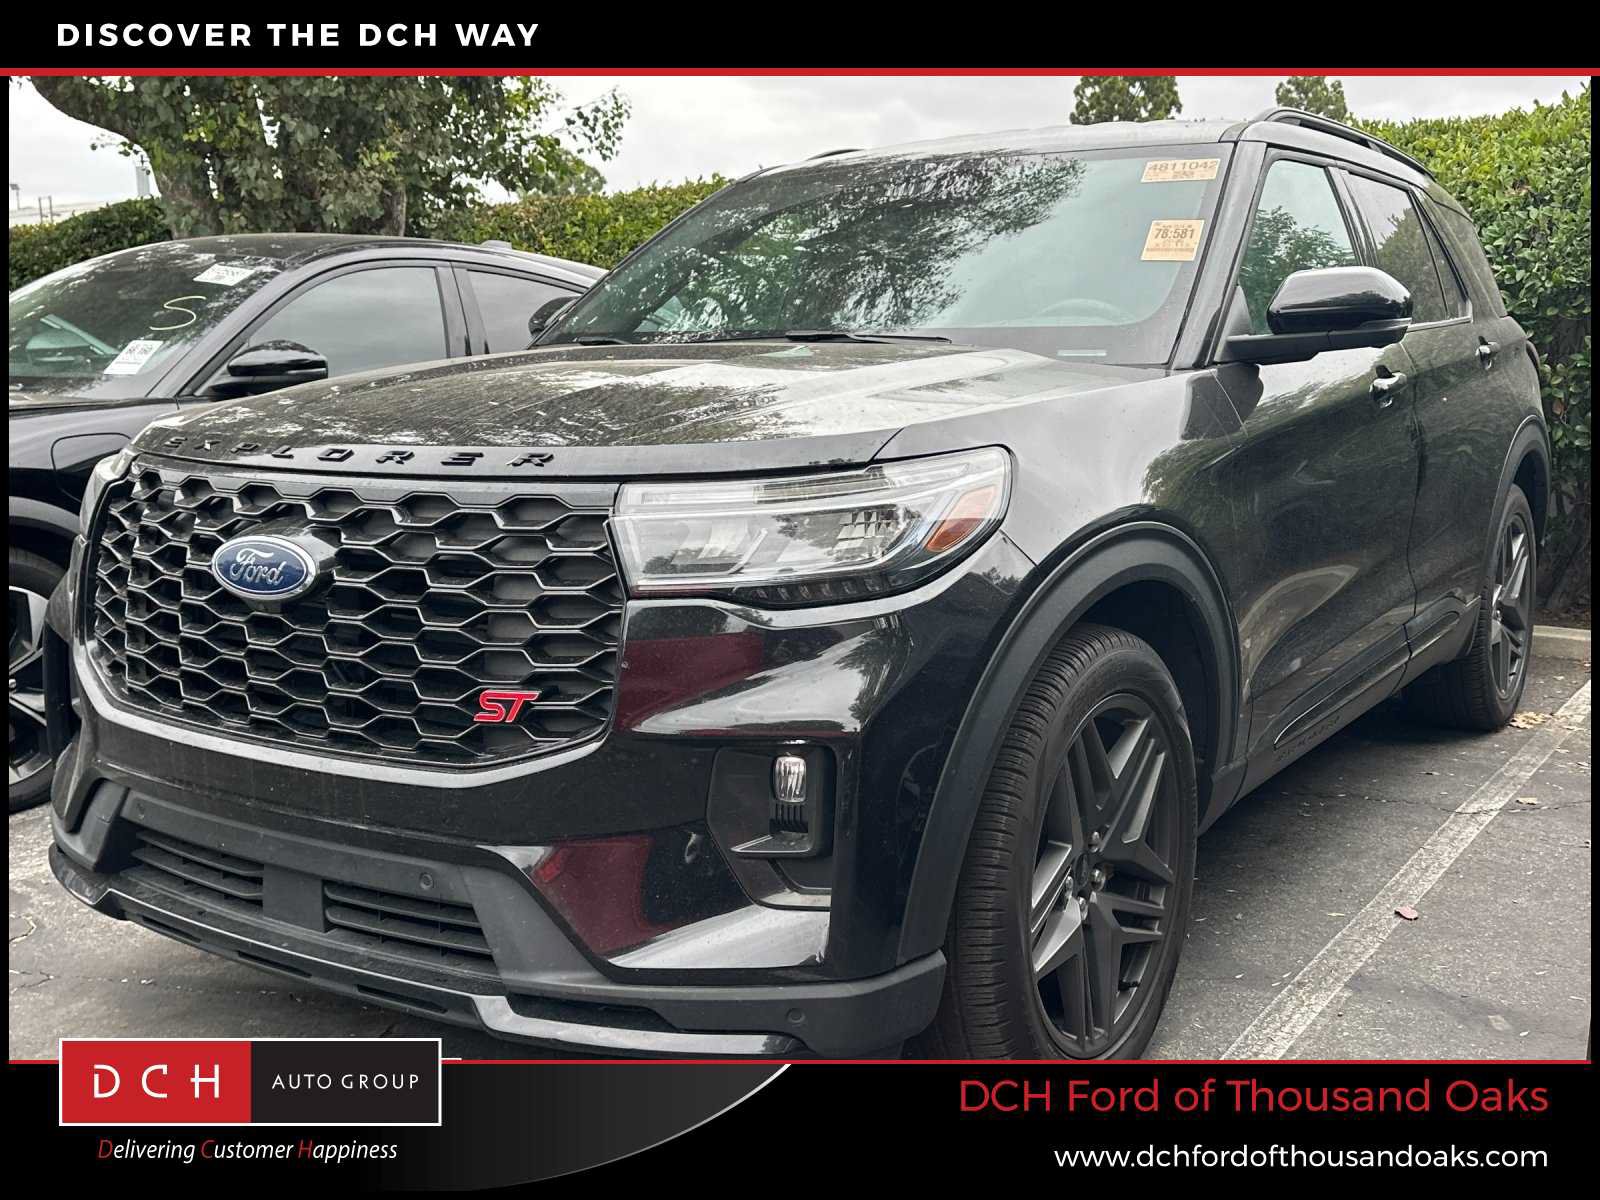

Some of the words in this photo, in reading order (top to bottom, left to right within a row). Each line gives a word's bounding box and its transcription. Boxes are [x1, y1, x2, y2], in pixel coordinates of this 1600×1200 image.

[164, 436, 555, 468] EXPLORER
[229, 547, 287, 586] Ford
[473, 690, 540, 723] ST
